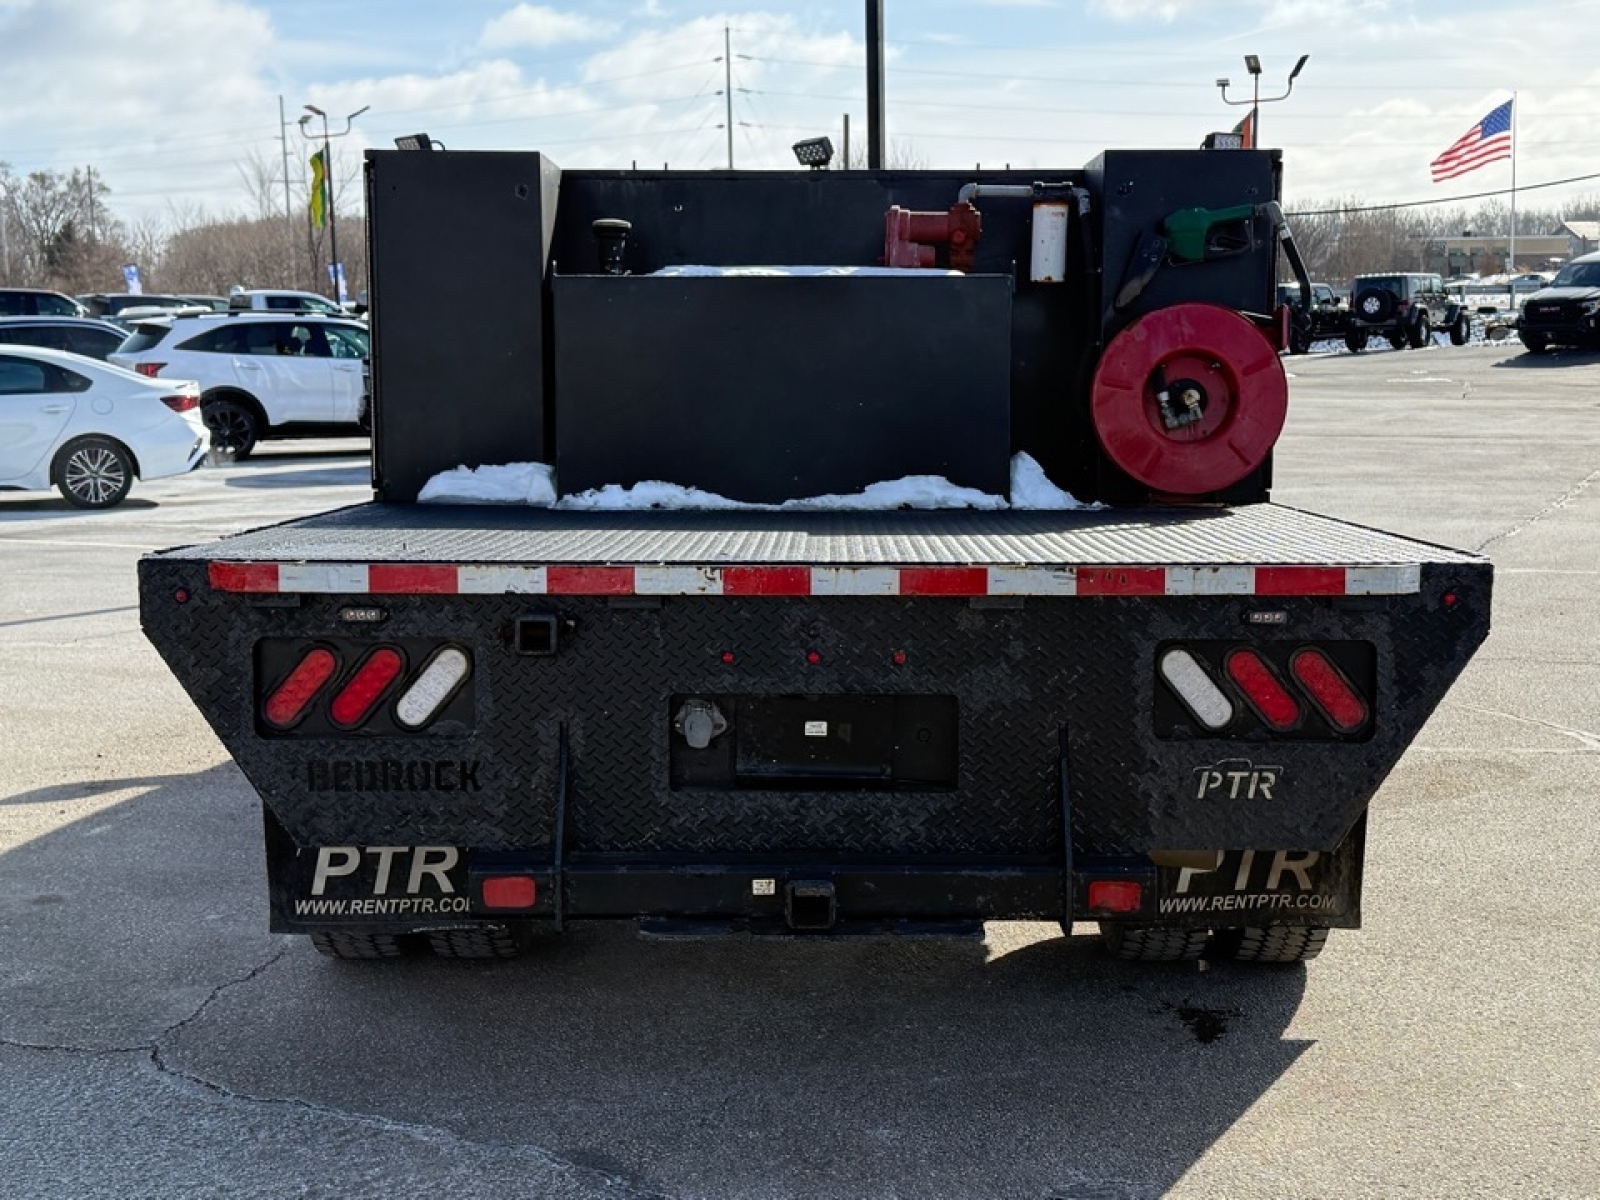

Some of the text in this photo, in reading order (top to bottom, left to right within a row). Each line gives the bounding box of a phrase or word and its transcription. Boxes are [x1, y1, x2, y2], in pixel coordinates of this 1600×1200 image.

[307, 760, 482, 792] BEDROCK
[1197, 771, 1277, 800] PTR
[311, 846, 459, 896] PTR
[295, 897, 470, 915] WWW.RENTPTR.CO
[1159, 895, 1336, 913] WWW.RENTPTR.COM
